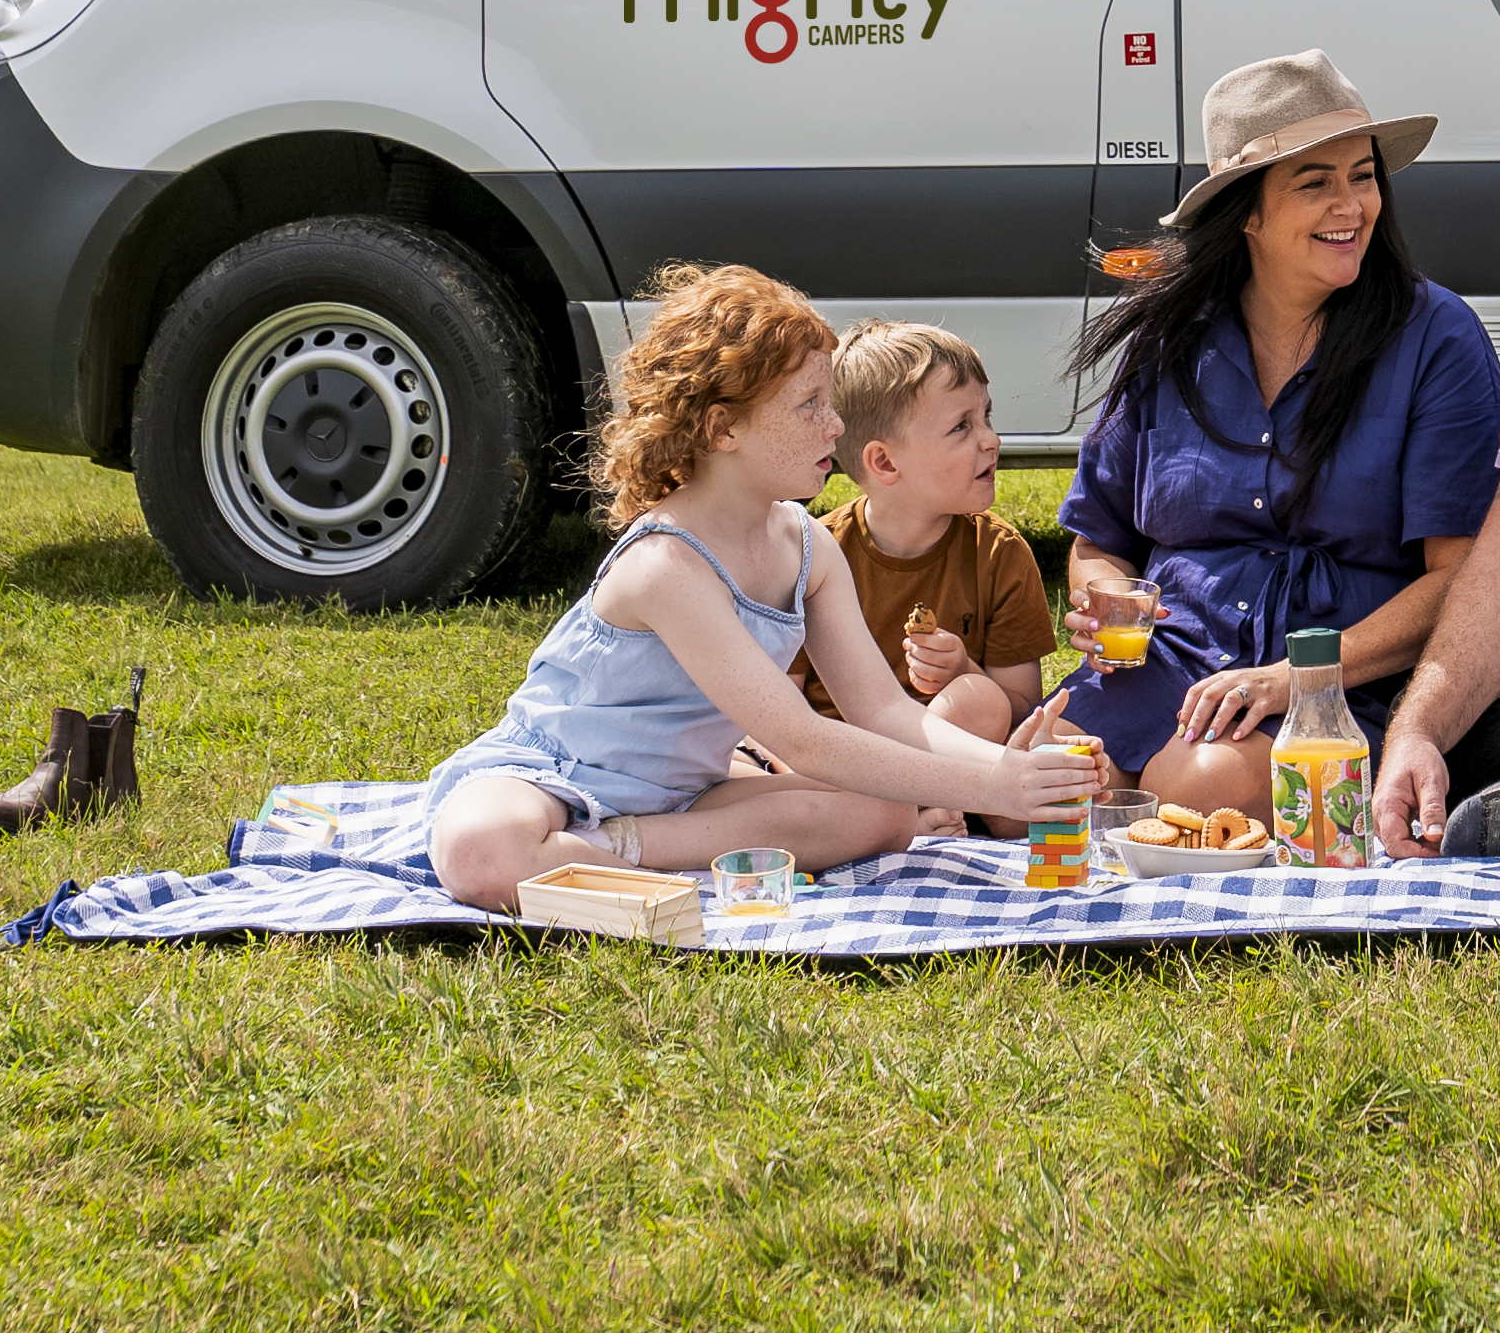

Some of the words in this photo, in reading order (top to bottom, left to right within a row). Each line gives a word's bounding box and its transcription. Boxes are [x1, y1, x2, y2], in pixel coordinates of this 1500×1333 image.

[808, 23, 905, 46] CAMPERS
[1133, 35, 1147, 45] NO
[1106, 141, 1169, 158] DIESEL
[429, 302, 487, 385] Continental
